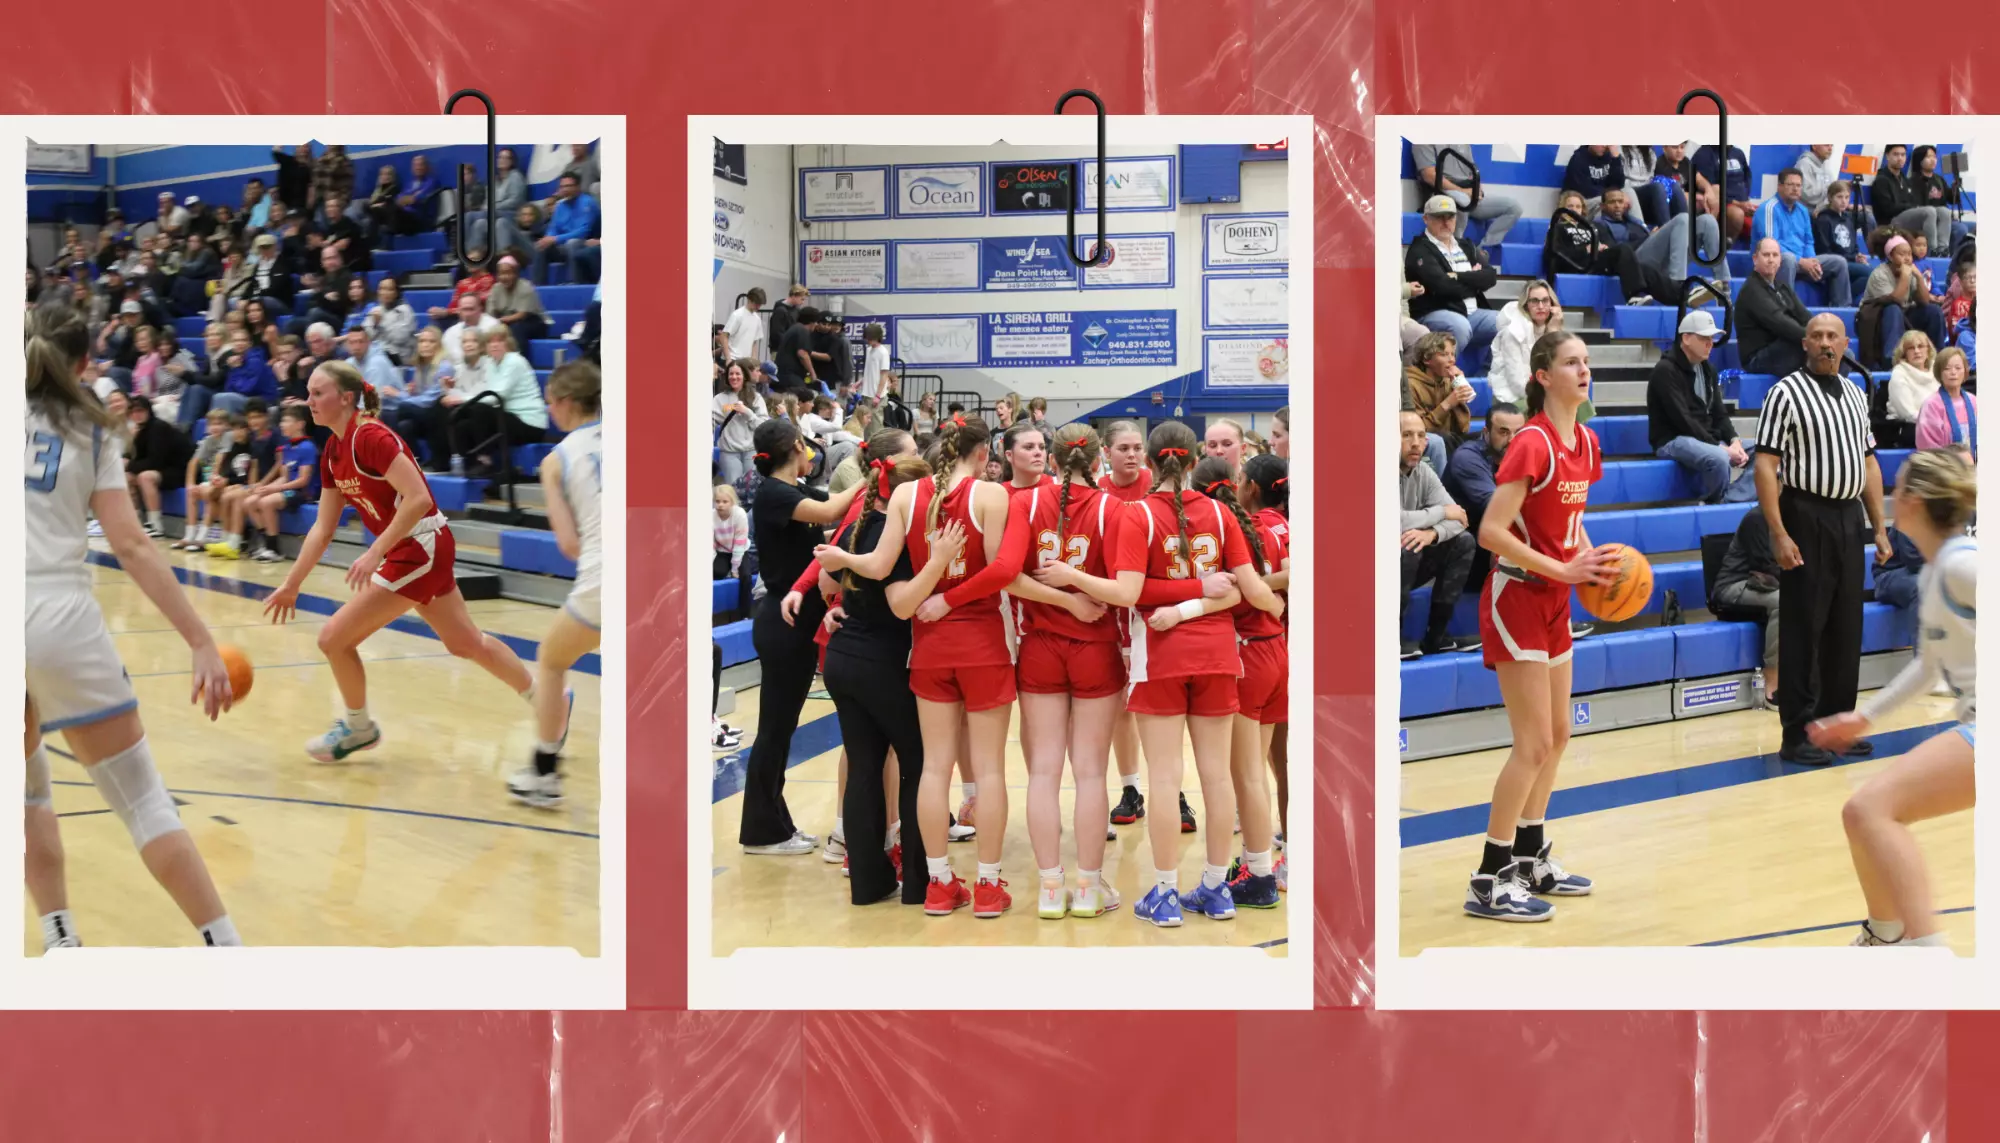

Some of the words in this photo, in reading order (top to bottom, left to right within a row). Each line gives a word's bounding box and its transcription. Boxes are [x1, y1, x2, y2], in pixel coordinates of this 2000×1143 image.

[909, 185, 975, 206] Ocean
[1228, 226, 1274, 238] DOHENY
[825, 249, 843, 257] ASIAN
[845, 247, 882, 257] KITCHEN
[1005, 248, 1027, 257] WIND
[1035, 248, 1051, 256] SEA
[995, 269, 1016, 278] Dana
[1017, 269, 1038, 277] Point
[1040, 268, 1068, 277] Harbor
[988, 314, 1002, 325] LA
[1005, 313, 1042, 325] SIRENA
[1045, 312, 1073, 323] GRILL
[994, 324, 1008, 333] the
[1042, 324, 1069, 334] eatery
[899, 330, 974, 353] gravity
[1108, 340, 1171, 349] 949.831.5500
[1082, 356, 1172, 366] ZacharyOrthodontics.com
[1037, 528, 1091, 573] 22
[1162, 532, 1219, 580] 32
